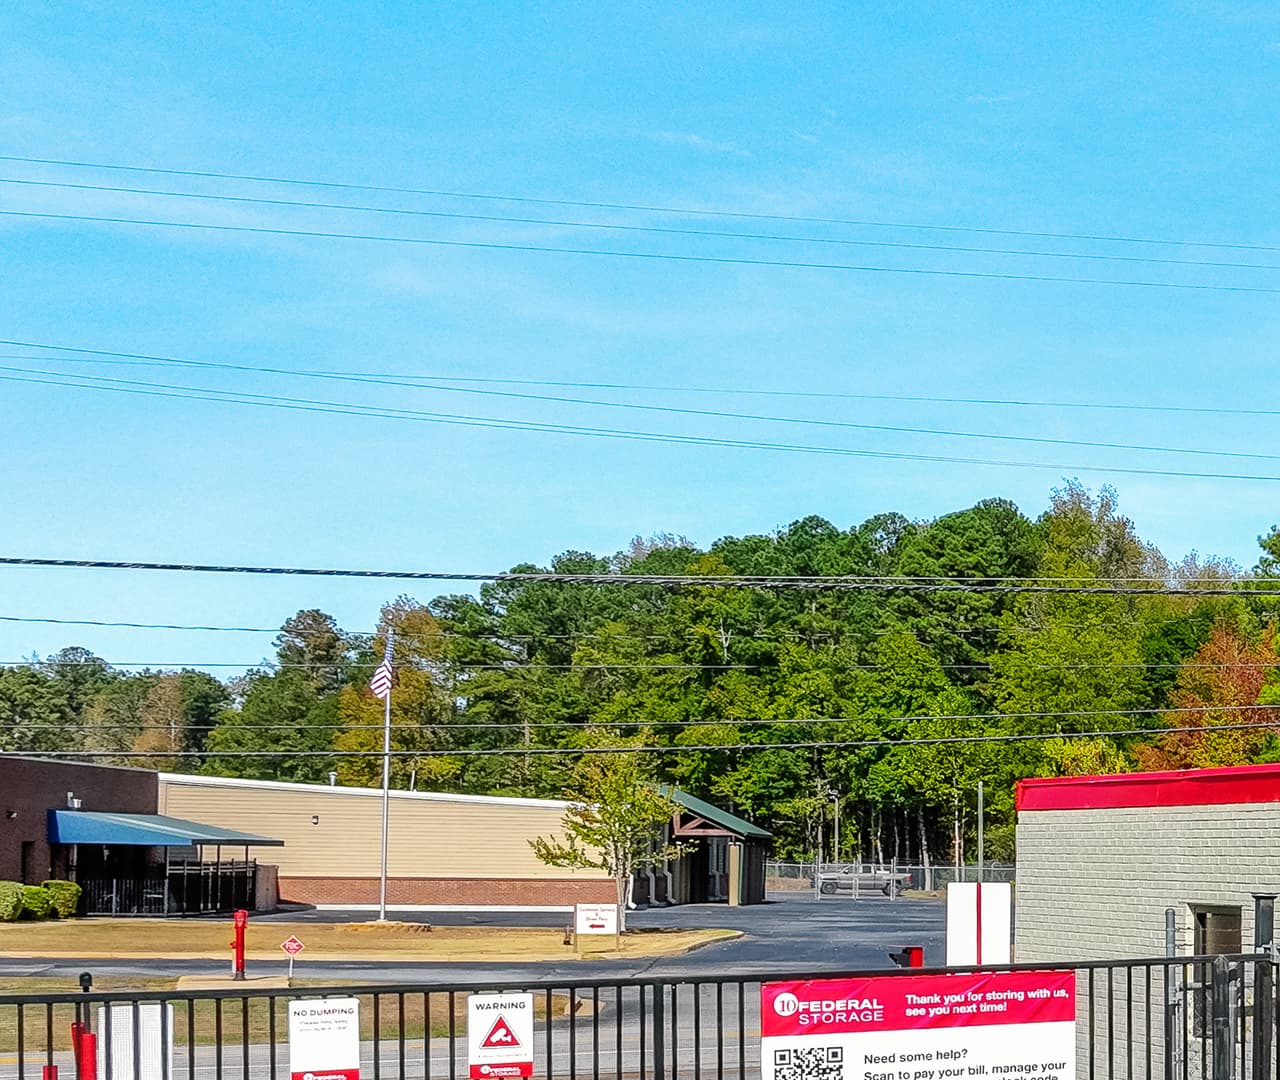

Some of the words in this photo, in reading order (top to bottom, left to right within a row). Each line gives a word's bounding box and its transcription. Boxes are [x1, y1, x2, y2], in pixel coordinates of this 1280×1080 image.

[905, 994, 942, 1005] Thank
[944, 994, 965, 1006] you
[967, 992, 984, 1002] for
[986, 990, 1024, 1001] storing
[1027, 988, 1050, 998] with
[1053, 988, 1069, 998] us,
[310, 1008, 354, 1016] DUMPING
[476, 1002, 526, 1010] WARNING
[798, 998, 884, 1012] FEDERAL
[905, 1007, 926, 1016] see
[928, 1006, 950, 1018] you
[952, 1004, 977, 1014] next
[979, 1002, 1007, 1012] time!
[798, 1010, 884, 1025] STORAGE
[864, 1053, 896, 1064] Need
[900, 1053, 933, 1063] some
[936, 1048, 968, 1061] help?
[898, 1071, 910, 1080] to
[914, 1070, 934, 1080] pay
[938, 1068, 965, 1080] your
[968, 1064, 988, 1076] bill,
[992, 1063, 1038, 1074] manage
[1041, 1062, 1067, 1072] your
